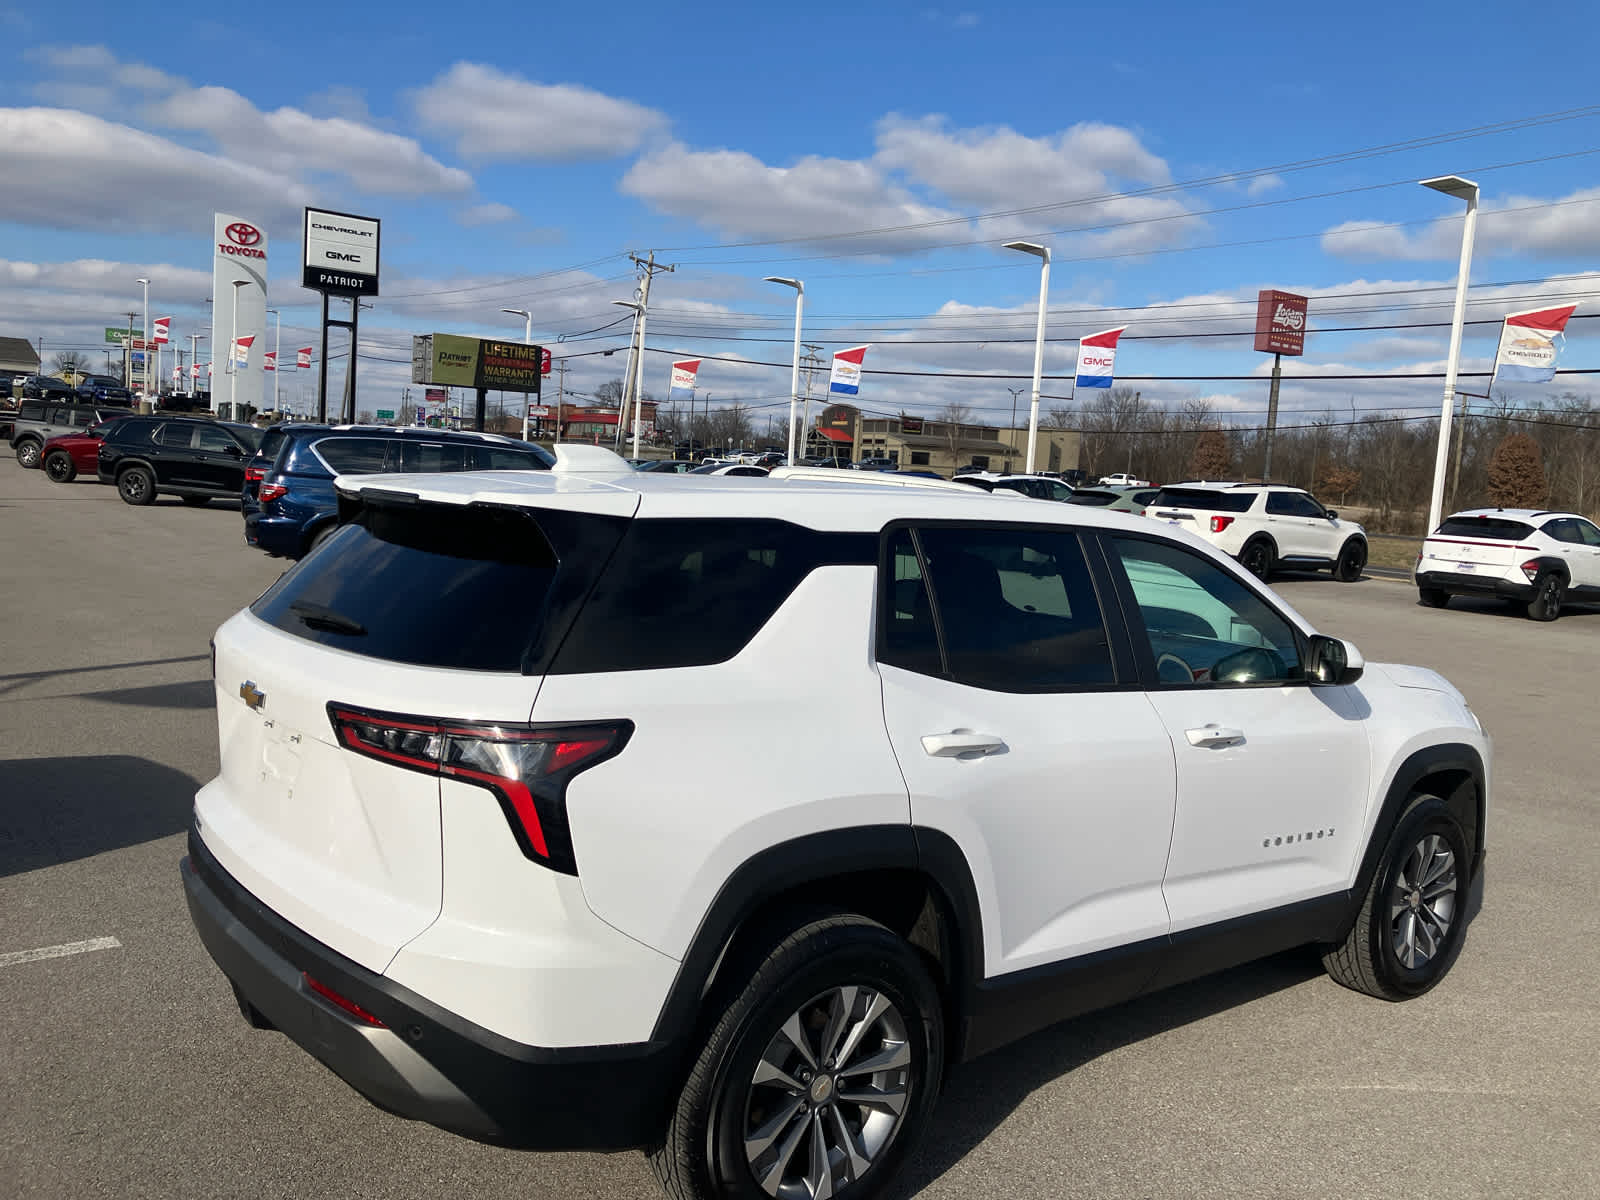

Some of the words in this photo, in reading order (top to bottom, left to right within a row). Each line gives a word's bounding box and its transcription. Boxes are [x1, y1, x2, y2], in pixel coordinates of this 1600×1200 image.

[311, 223, 373, 237] CHEVROLET
[218, 244, 266, 260] TOYOTA
[325, 251, 361, 263] GMC
[319, 274, 364, 289] PATRIOT
[484, 343, 536, 360] LIFETIME
[1508, 350, 1552, 359] CHEVROLET
[1084, 357, 1112, 366] GMC
[484, 366, 535, 379] WARRANTY
[675, 375, 694, 384] GMC
[1263, 828, 1336, 848] EQUINOX
